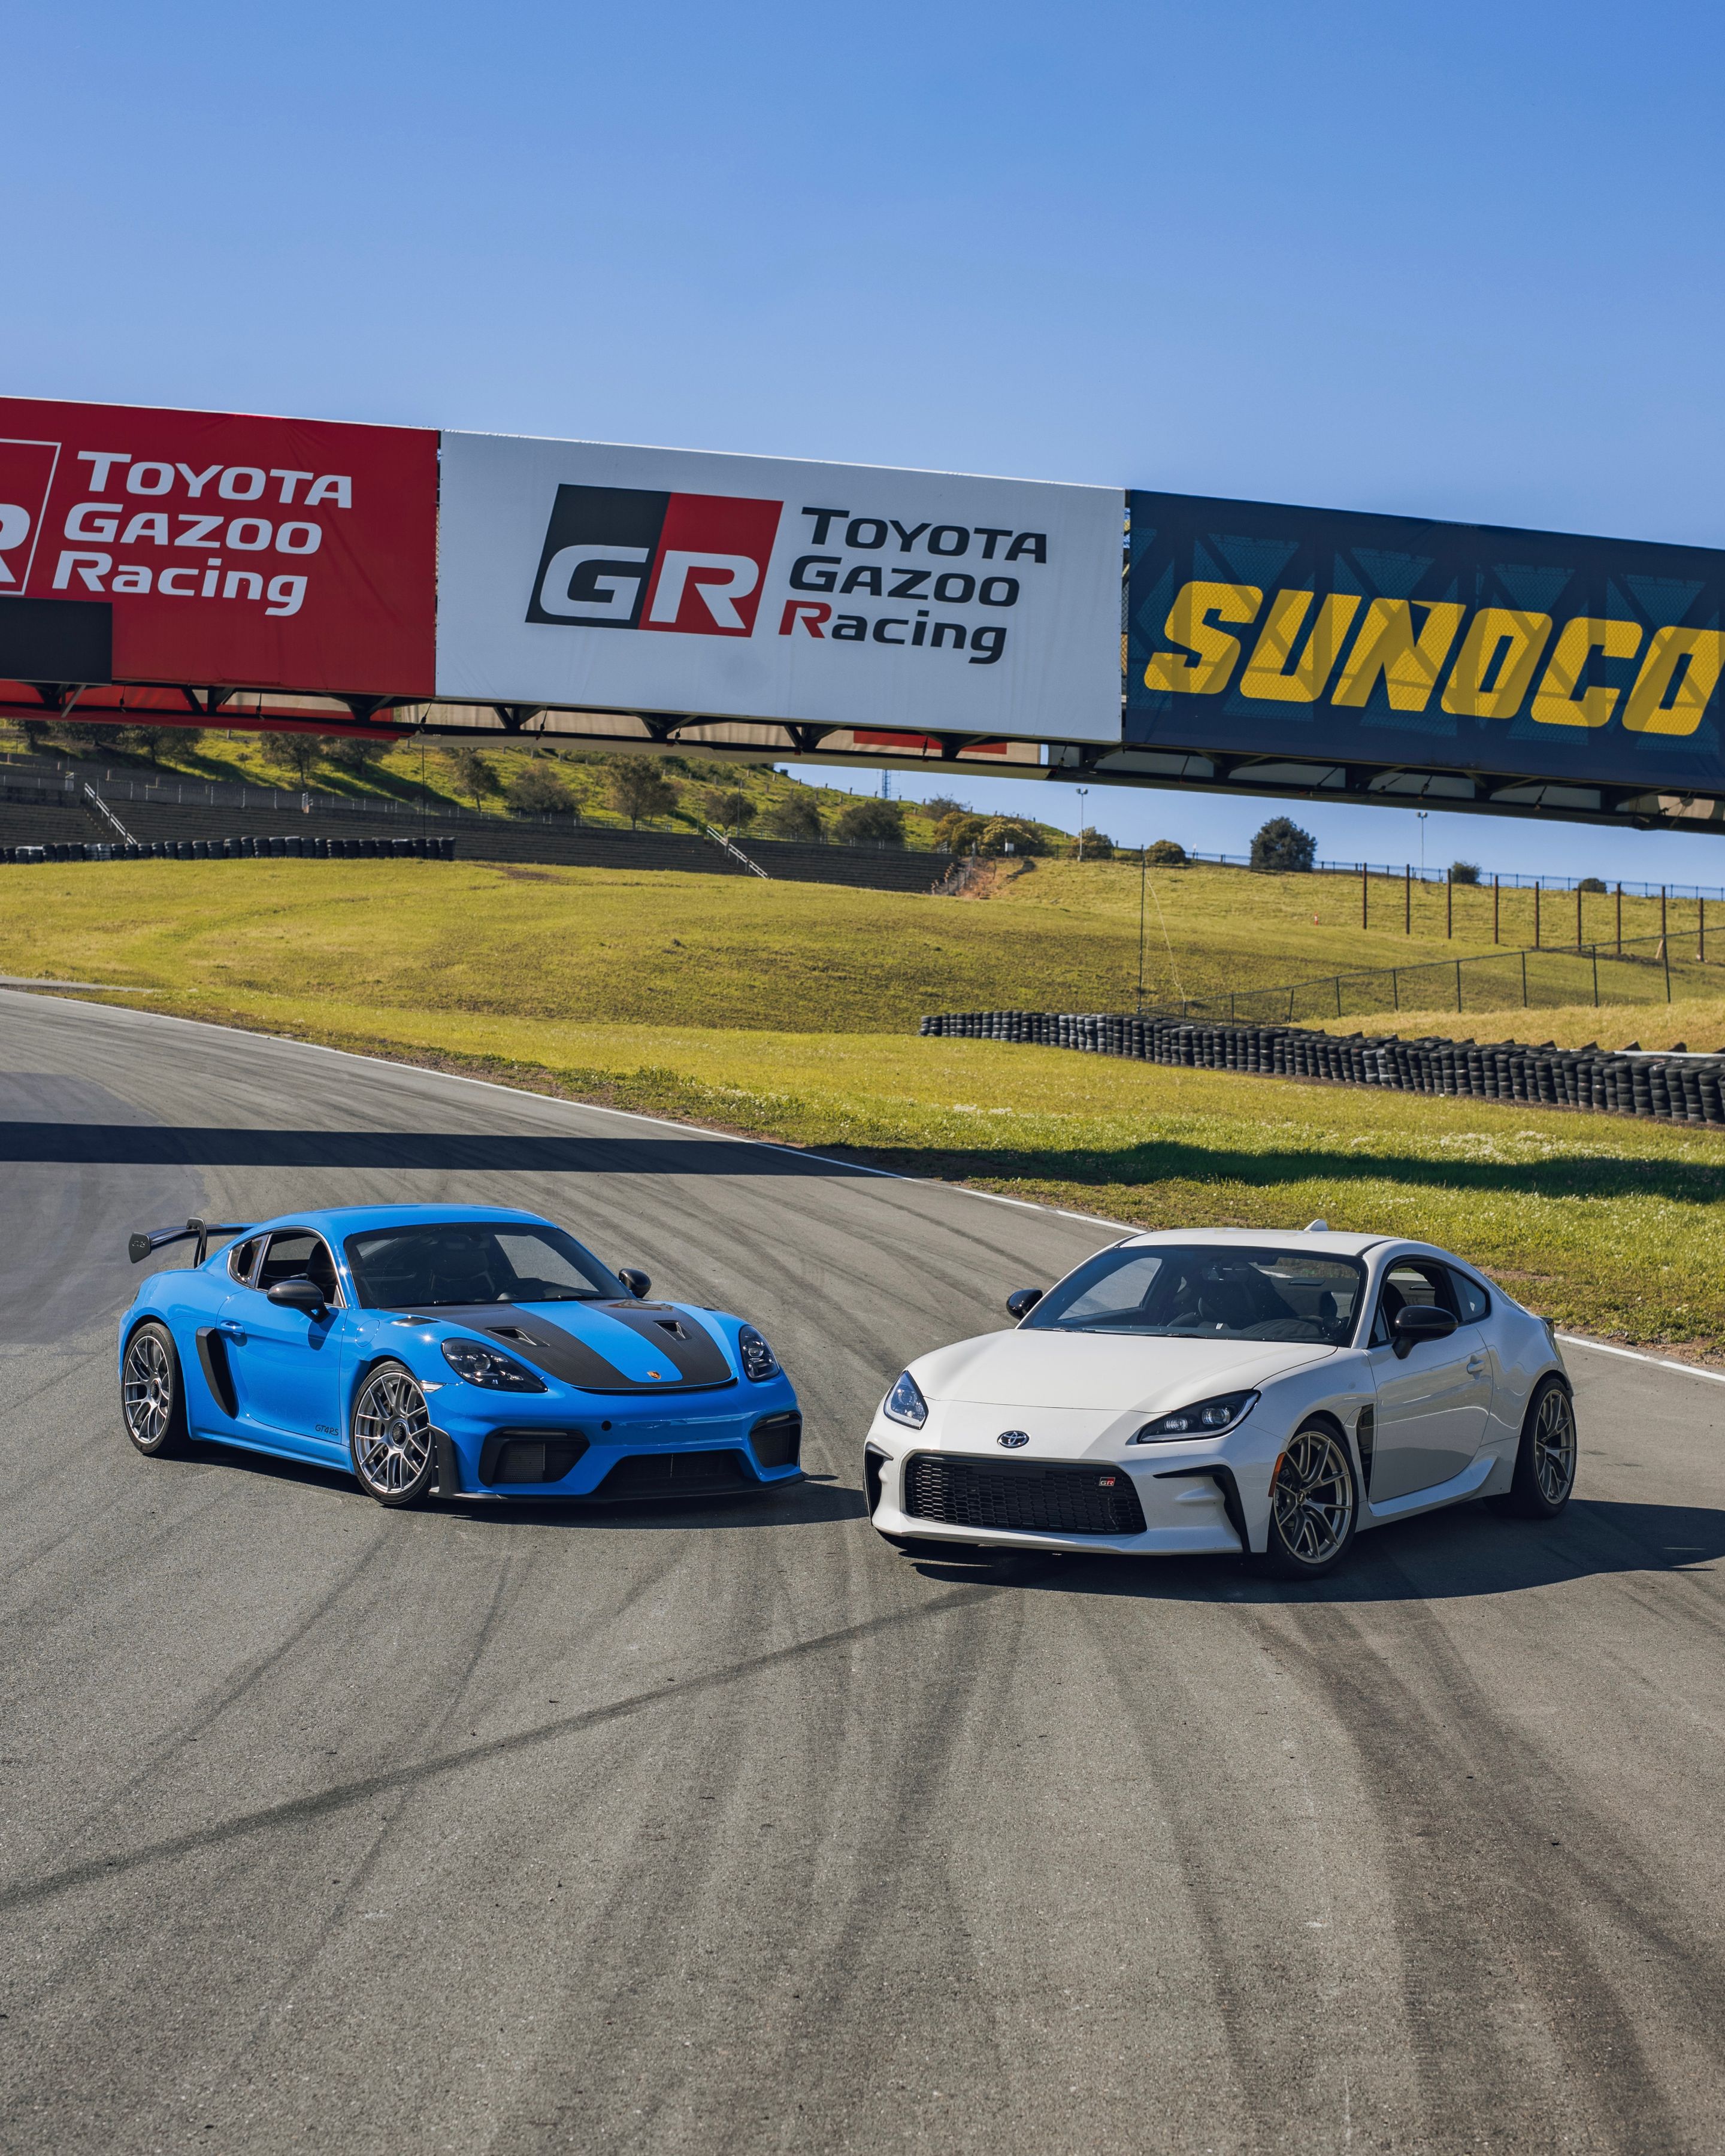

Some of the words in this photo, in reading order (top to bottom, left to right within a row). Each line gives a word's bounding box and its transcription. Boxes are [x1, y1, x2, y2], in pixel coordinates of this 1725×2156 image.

[77, 450, 352, 508] TOYOTA
[63, 502, 323, 555] GAZOO
[801, 506, 1048, 564] TOYOTA
[52, 550, 308, 616] Racing
[540, 544, 759, 629] GR
[789, 555, 1021, 607] GAZOO
[778, 599, 1007, 665] Racing
[1144, 581, 1725, 735] SUNOCO
